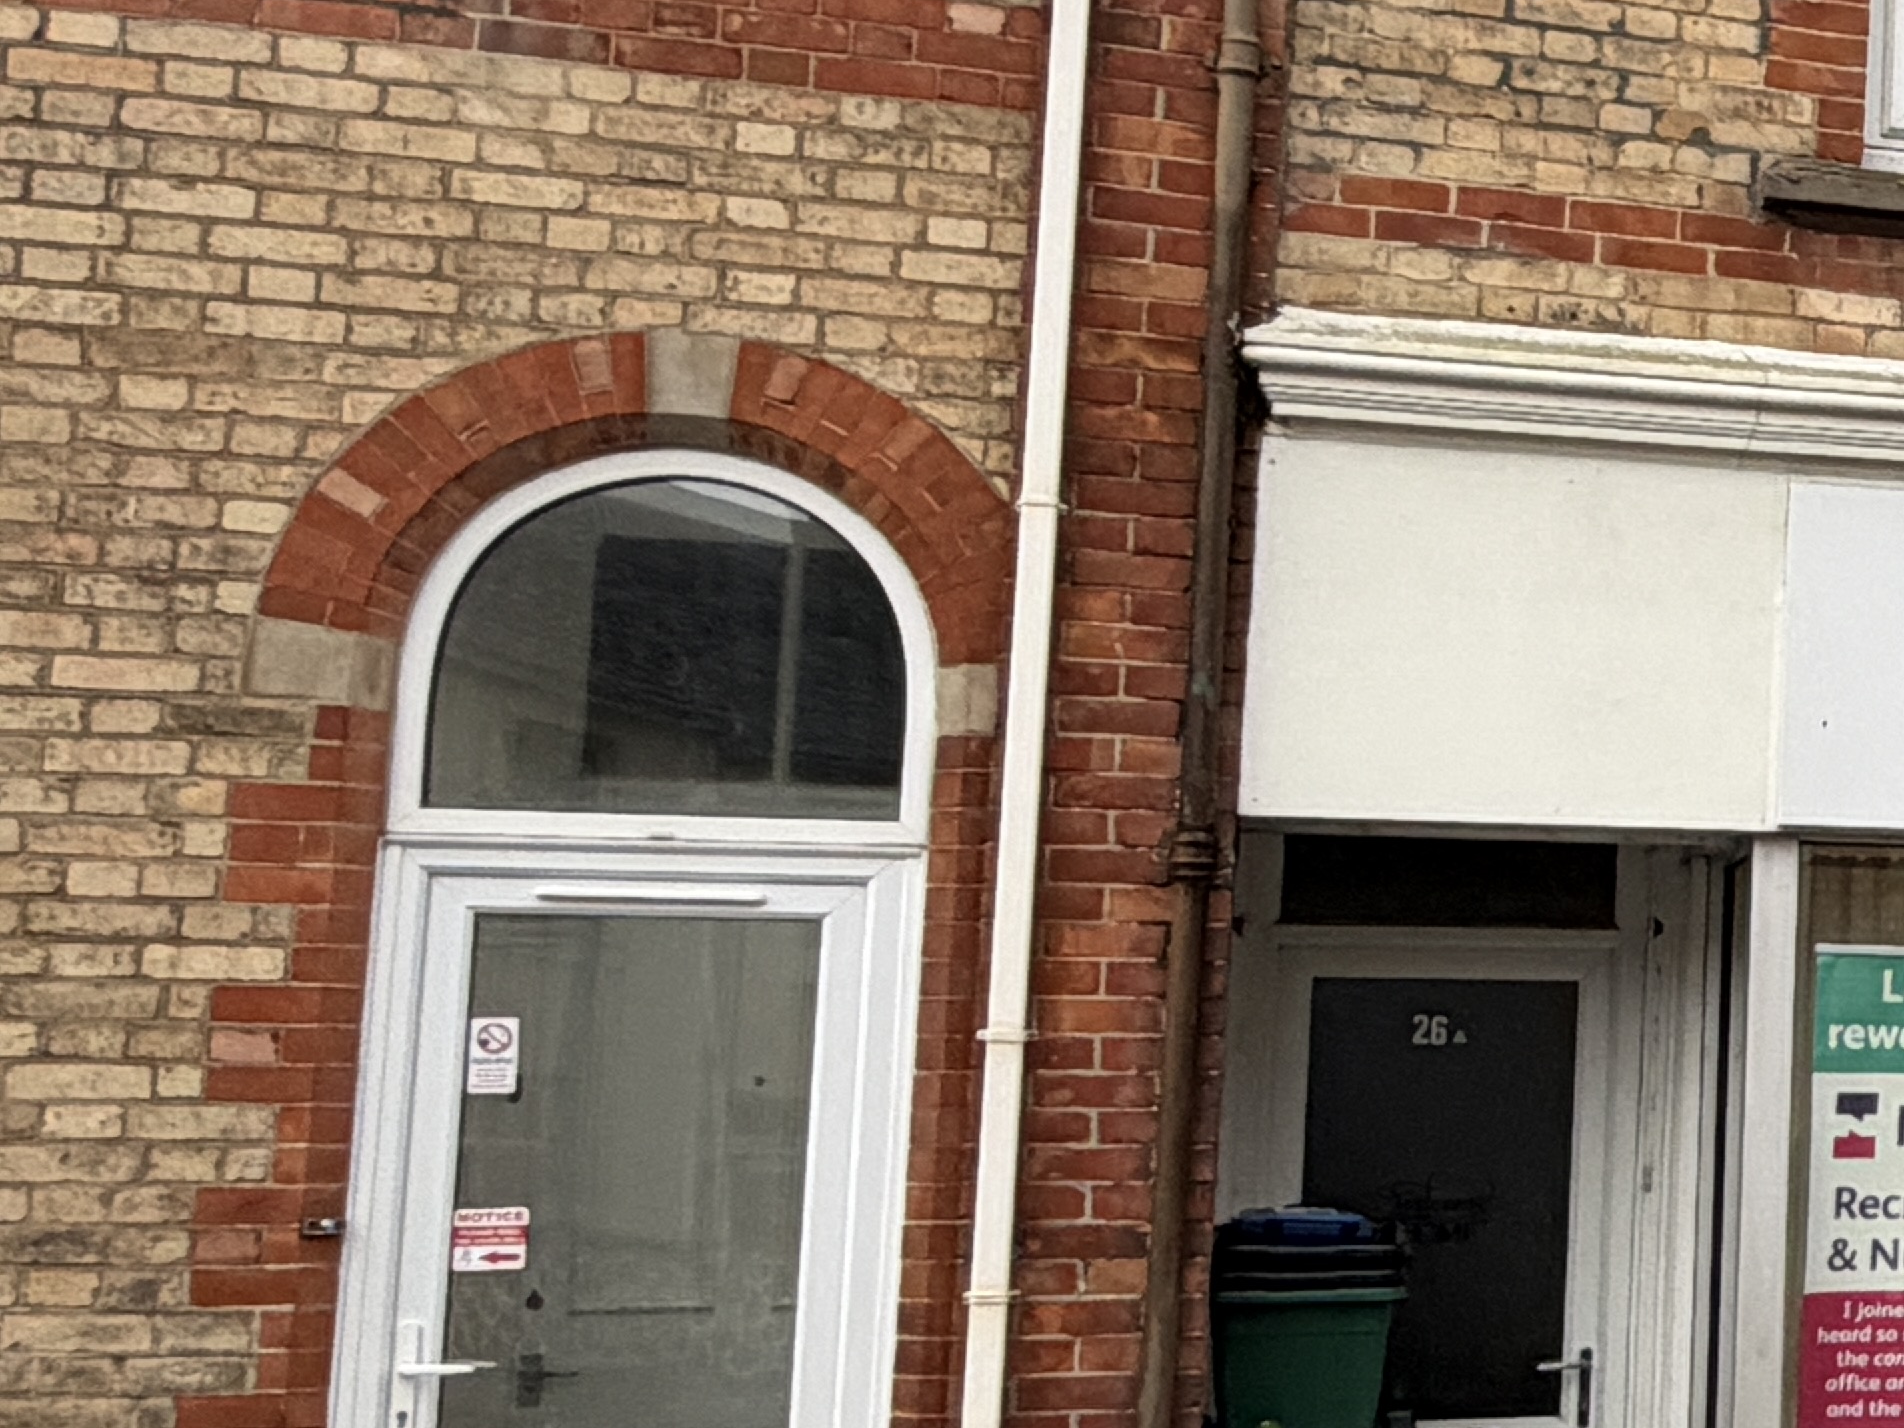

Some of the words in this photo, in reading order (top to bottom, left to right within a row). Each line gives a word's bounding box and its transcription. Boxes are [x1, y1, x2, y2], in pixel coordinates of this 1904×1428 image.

[1827, 1238, 1858, 1272] &
[1843, 1300, 1852, 1319] I
[1817, 1324, 1872, 1345] heard
[1876, 1328, 1898, 1343] so
[1837, 1349, 1869, 1368] the
[1825, 1372, 1881, 1392] office
[1826, 1398, 1864, 1418] and
[1869, 1397, 1902, 1416] the
